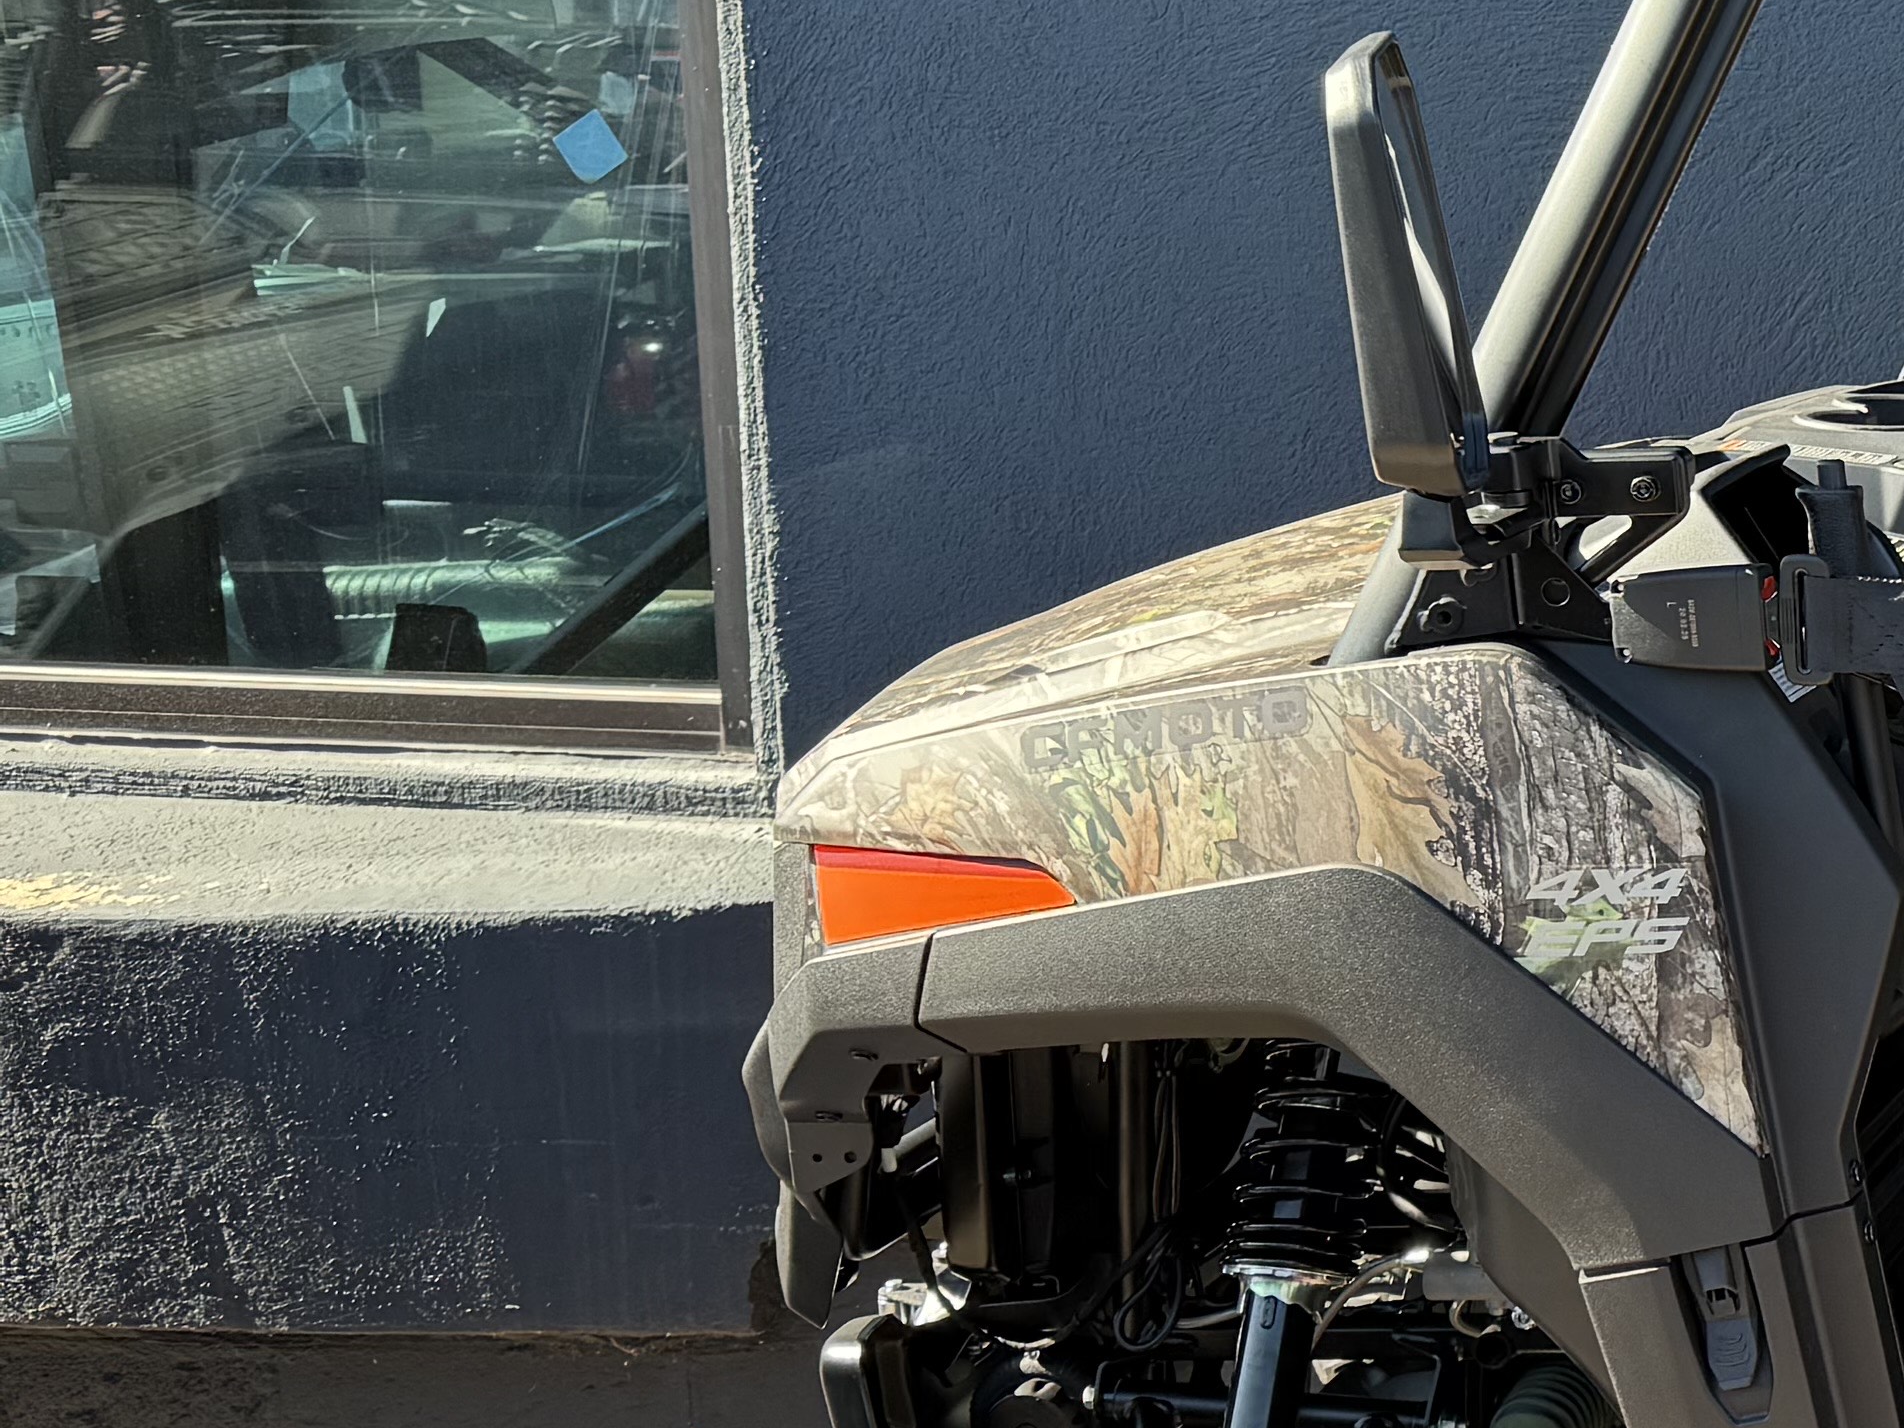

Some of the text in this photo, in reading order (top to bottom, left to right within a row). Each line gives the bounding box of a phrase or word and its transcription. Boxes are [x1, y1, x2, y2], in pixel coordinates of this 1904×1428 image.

[1019, 685, 1310, 769] CFMOTO
[1526, 868, 1688, 911] 4X4
[1521, 916, 1690, 958] EPS
